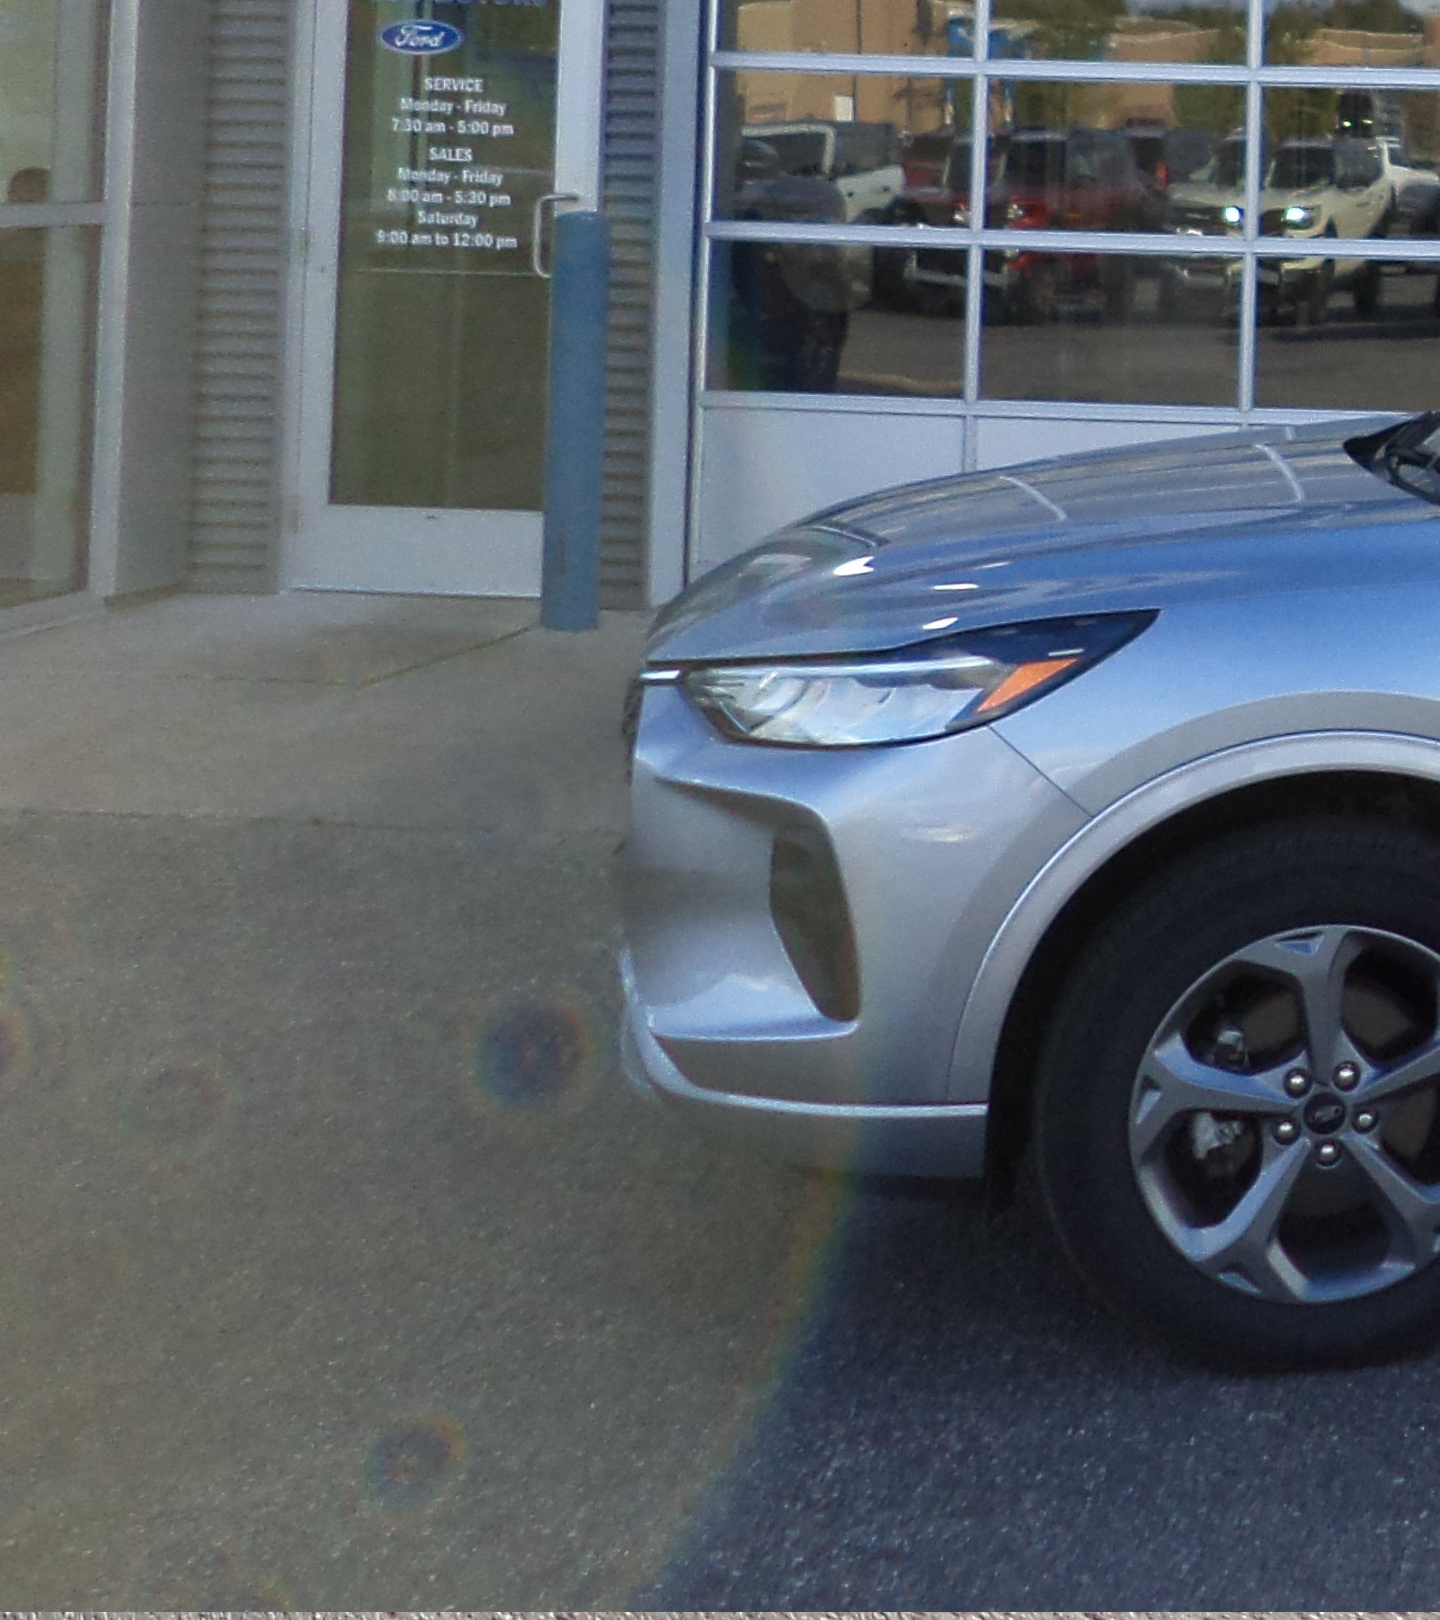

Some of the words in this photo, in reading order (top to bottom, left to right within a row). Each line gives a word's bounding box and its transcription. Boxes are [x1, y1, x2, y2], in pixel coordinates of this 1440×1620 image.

[424, 77, 484, 92] SERVICE
[400, 97, 453, 115] Monday
[464, 99, 506, 116] Friday
[425, 121, 446, 132] am
[493, 124, 514, 136] pm
[429, 146, 473, 162] SALES
[398, 167, 450, 184] Monday
[462, 169, 503, 187] Friday
[422, 192, 443, 203] am
[454, 190, 487, 204] 5:30
[489, 194, 511, 208] pm
[418, 210, 479, 229] Saturday
[377, 229, 408, 244] 9:00
[411, 233, 433, 245] am
[435, 233, 449, 246] to
[453, 233, 493, 248] 12:00
[496, 236, 518, 250] pm
